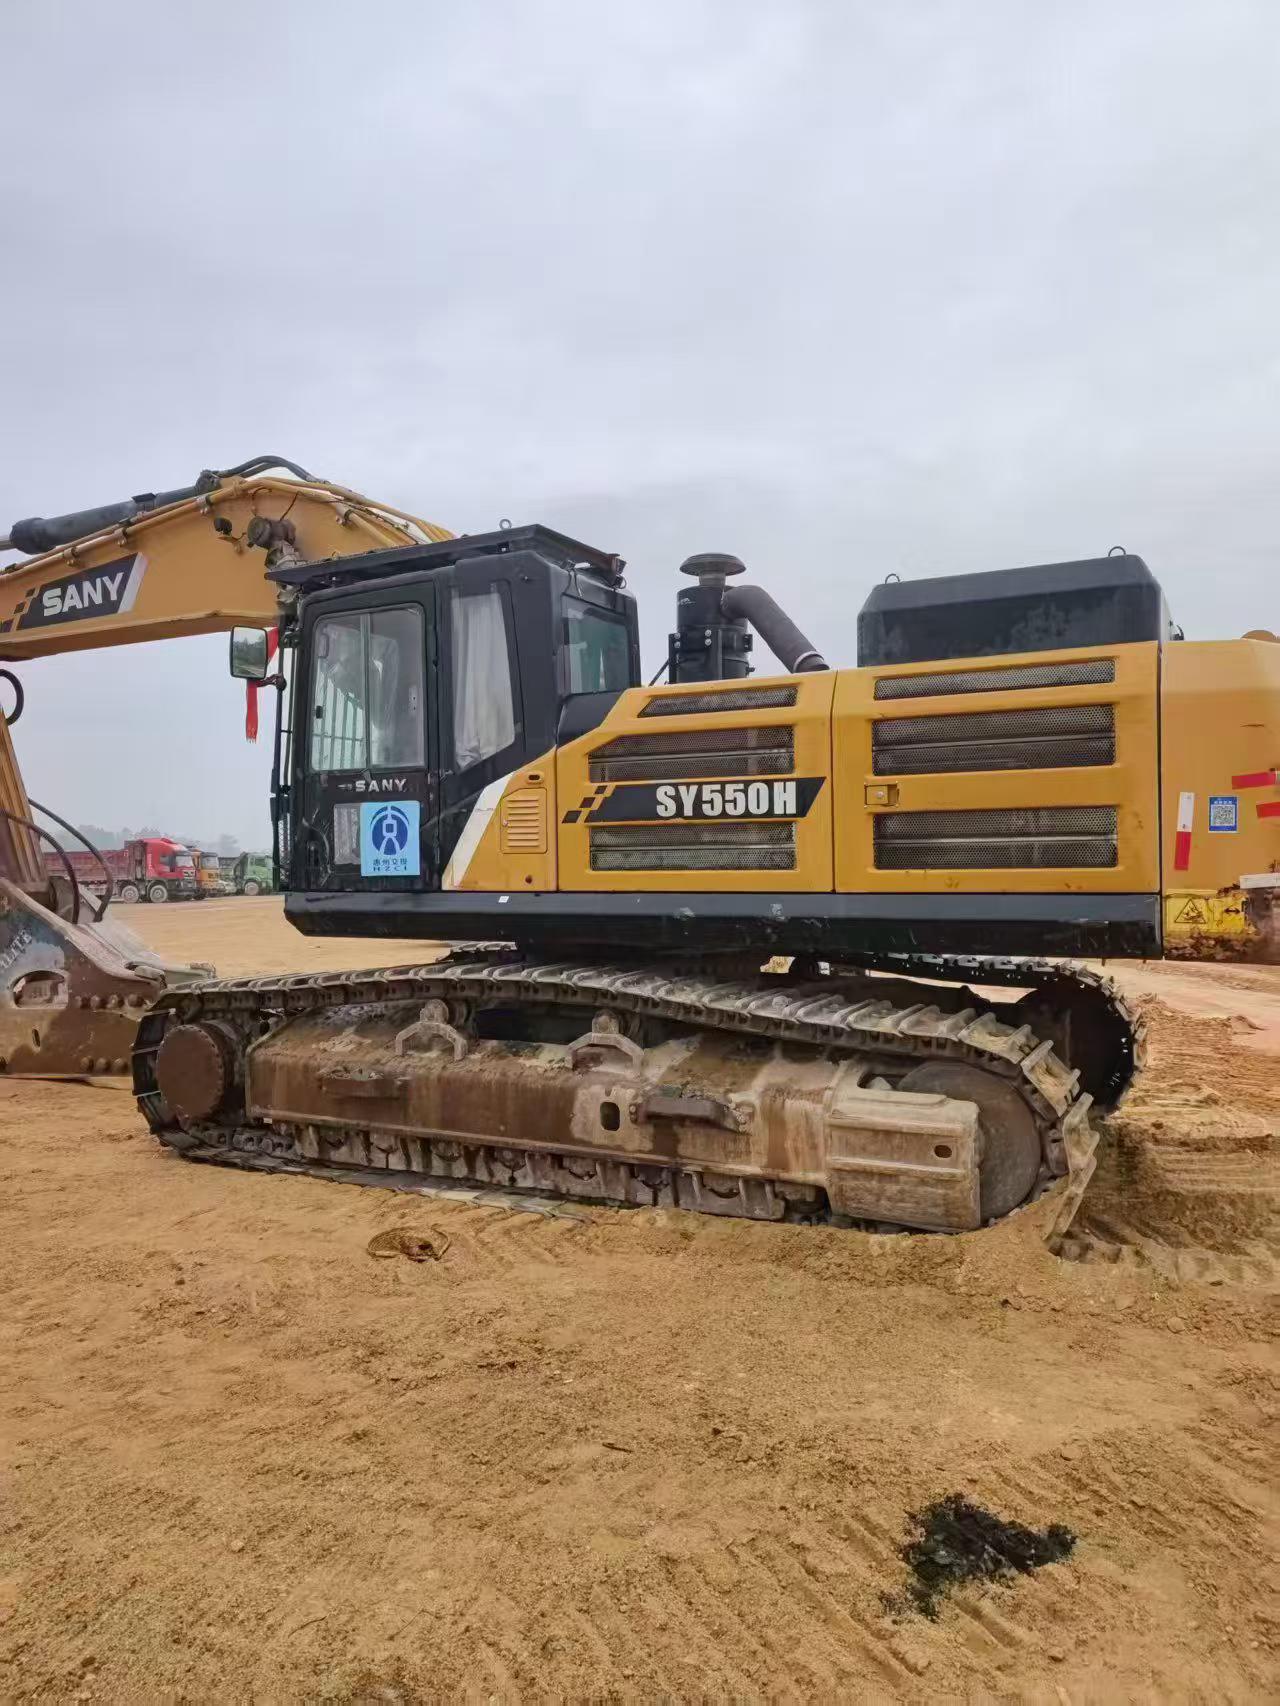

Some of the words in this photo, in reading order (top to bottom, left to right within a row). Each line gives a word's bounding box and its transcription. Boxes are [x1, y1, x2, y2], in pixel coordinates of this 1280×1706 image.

[42, 571, 125, 617] SANY
[355, 778, 407, 793] SANY
[655, 781, 797, 818] SY550H
